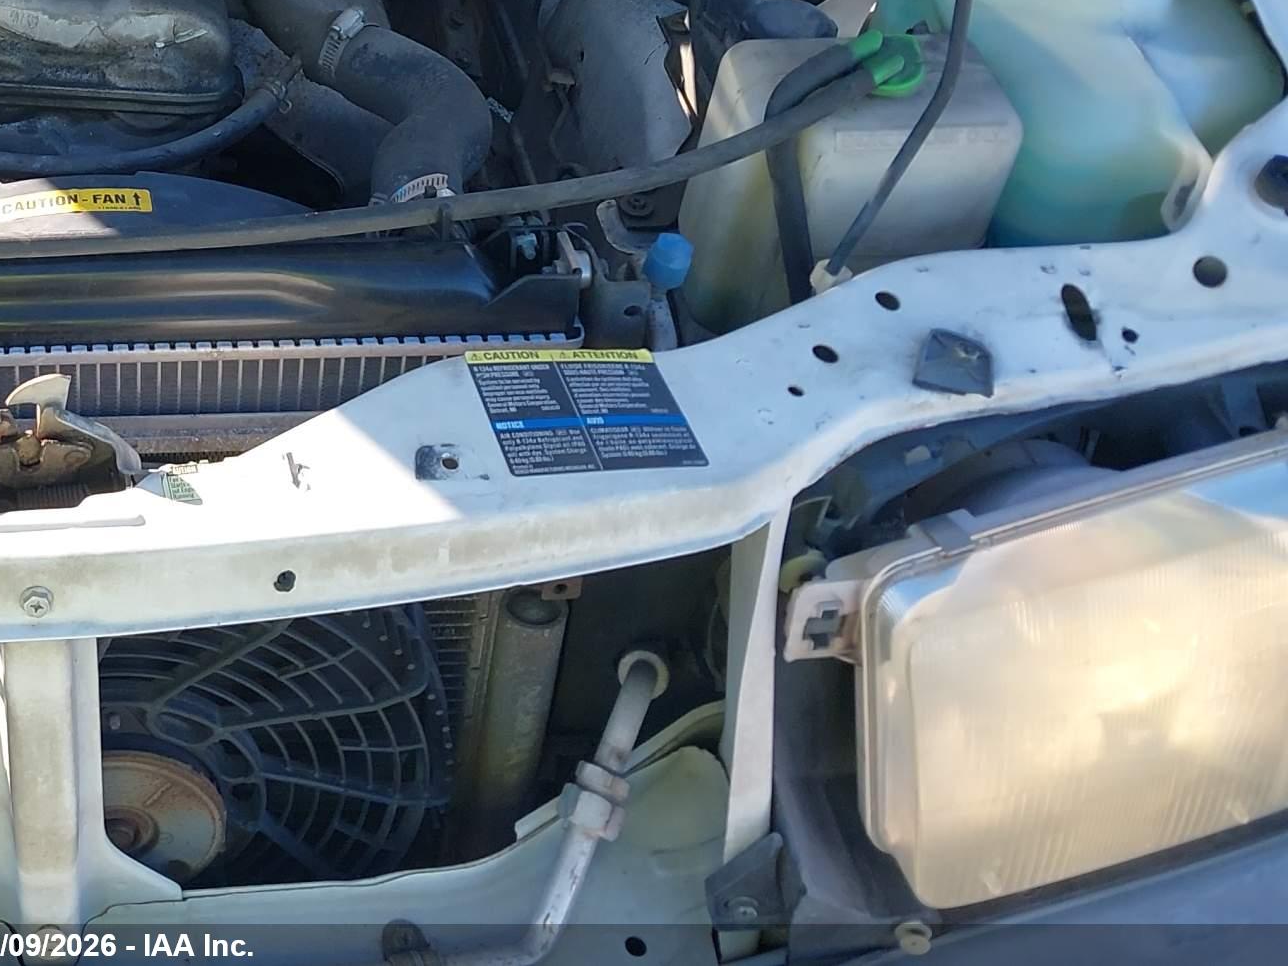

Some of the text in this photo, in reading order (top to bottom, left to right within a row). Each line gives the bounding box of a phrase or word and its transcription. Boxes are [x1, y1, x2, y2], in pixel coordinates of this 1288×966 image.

[1, 193, 79, 216] CAUTION
[92, 193, 127, 205] FAN
[483, 351, 540, 361] CAUTION
[572, 351, 639, 361] ATTENTION
[495, 421, 525, 430] NOTICE
